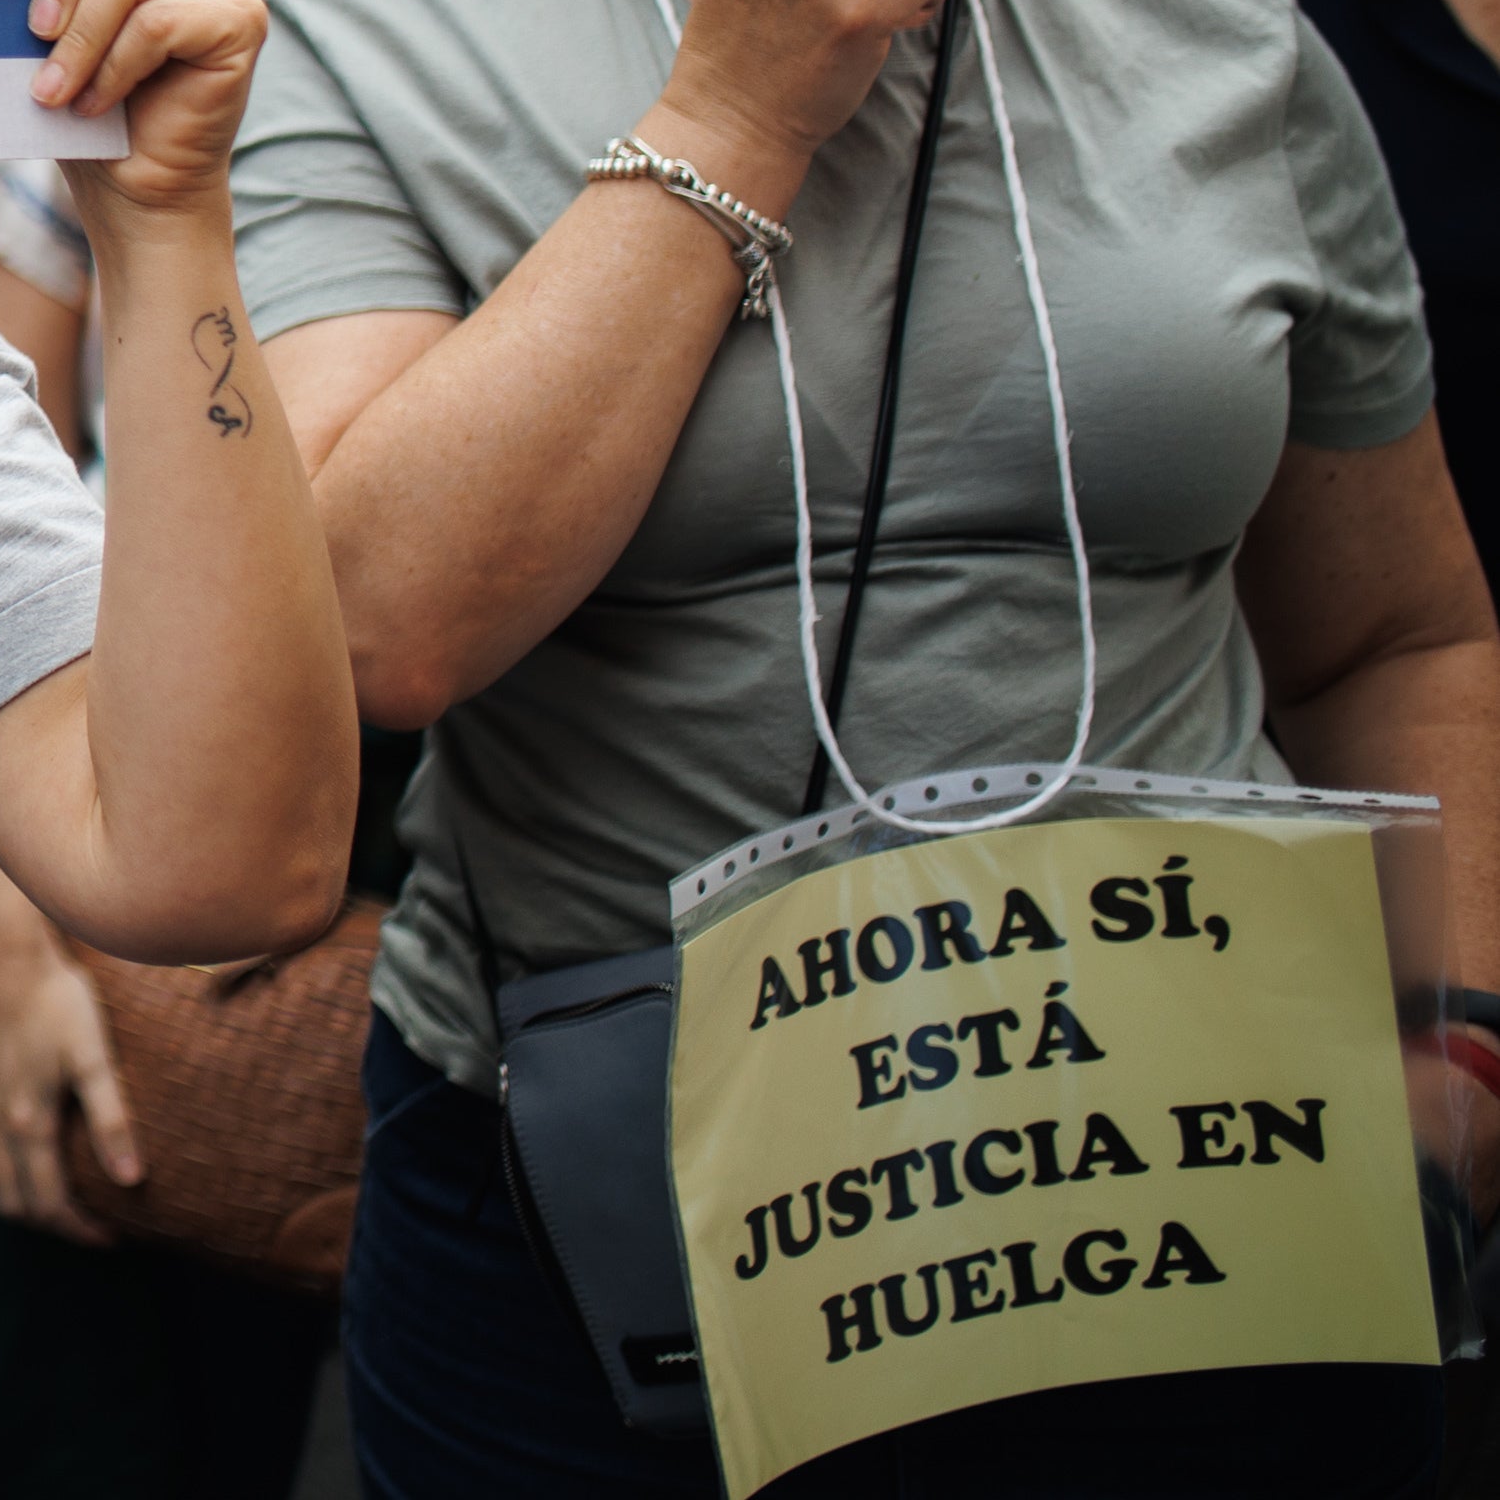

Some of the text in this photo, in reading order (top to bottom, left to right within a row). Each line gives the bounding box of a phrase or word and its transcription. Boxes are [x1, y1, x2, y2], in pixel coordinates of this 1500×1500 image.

[750, 856, 1231, 1030] AHORA SÍ,
[849, 982, 1106, 1110] ESTÁ
[734, 1098, 1327, 1281] JUSTICIA EN
[820, 1221, 1227, 1364] HUELGA
